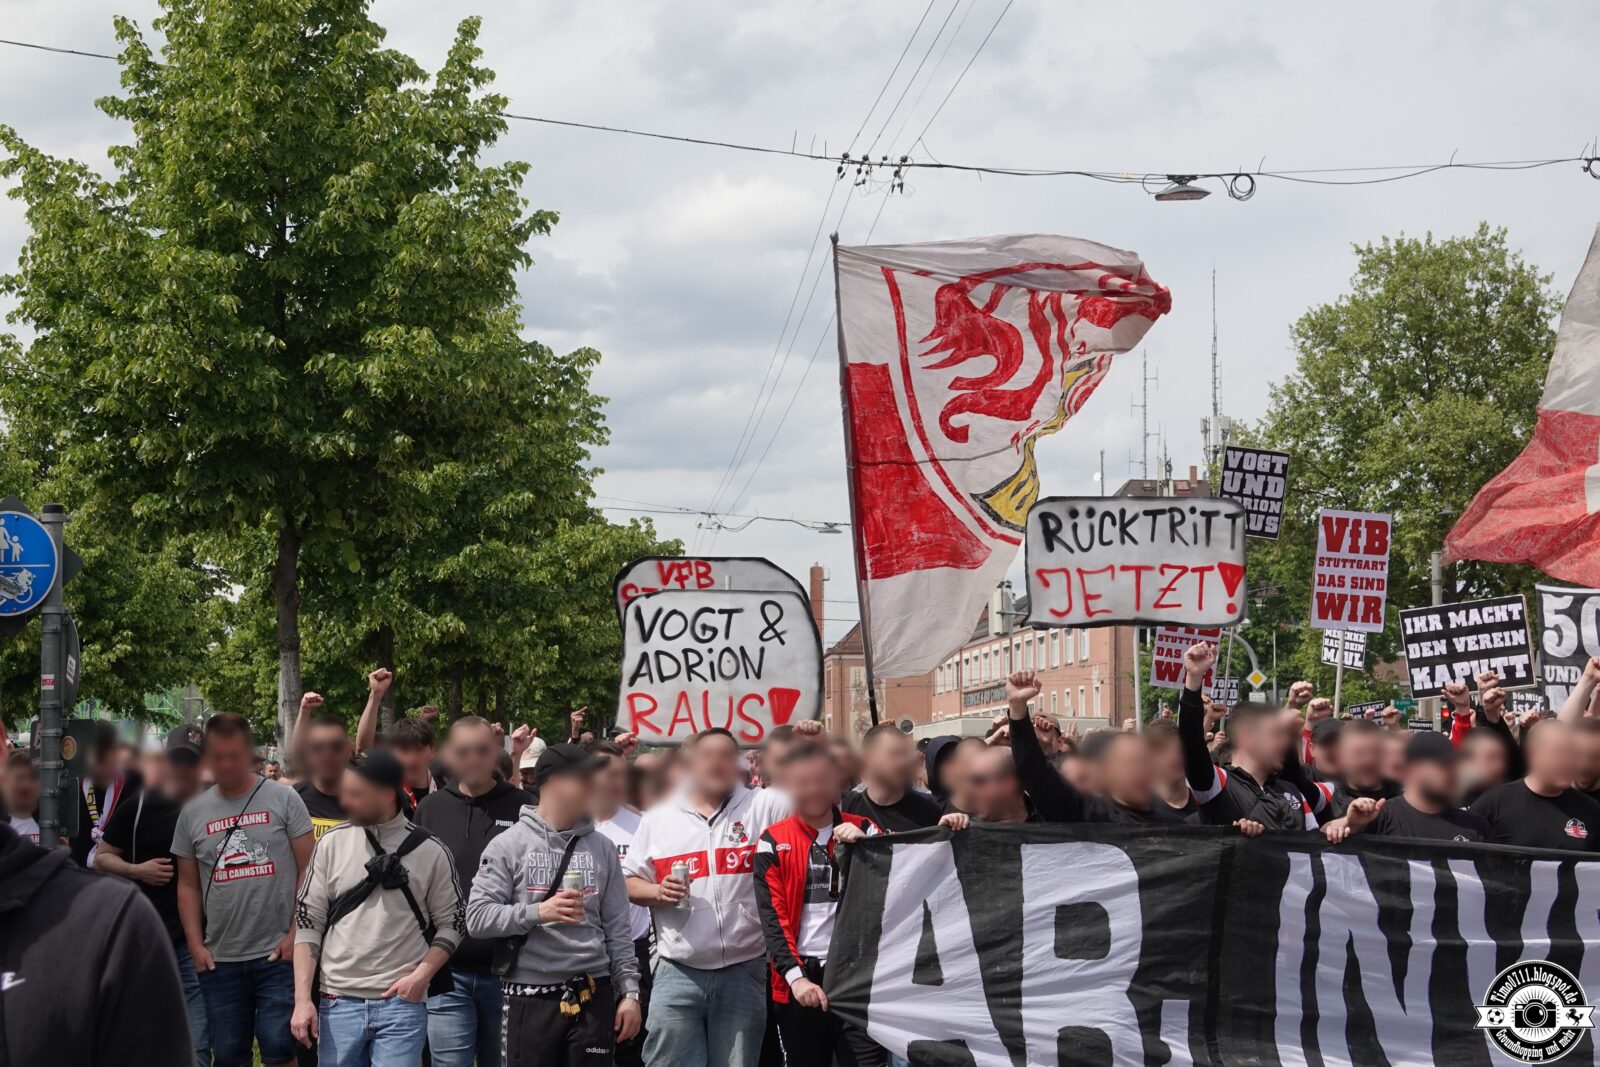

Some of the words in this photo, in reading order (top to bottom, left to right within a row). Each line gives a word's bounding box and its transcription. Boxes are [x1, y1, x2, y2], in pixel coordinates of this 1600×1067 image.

[1226, 450, 1288, 474] VOGT
[1223, 470, 1285, 498] UND
[1222, 494, 1281, 513] RION
[1322, 516, 1389, 556] VfB
[1318, 557, 1386, 571] STUTTGART
[1036, 562, 1246, 617] JETZT!
[1317, 575, 1345, 588] DAS
[1351, 577, 1385, 591] SIND
[1316, 592, 1382, 624] WIR
[1404, 614, 1443, 635] IHR
[1448, 603, 1523, 629] MACHT
[634, 606, 744, 643] VOGT
[758, 600, 787, 645] &
[1156, 646, 1182, 659] DAS
[1407, 639, 1447, 659] DEN
[1452, 629, 1526, 653] VEREIN
[1411, 654, 1529, 691] KAPUTT
[1543, 665, 1582, 684] UND
[626, 687, 800, 743] RAUS!
[208, 817, 235, 834] VOLLE
[229, 864, 273, 879] CANNSTATT
[527, 852, 594, 870] SCHWBEN
[726, 851, 752, 869] 97
